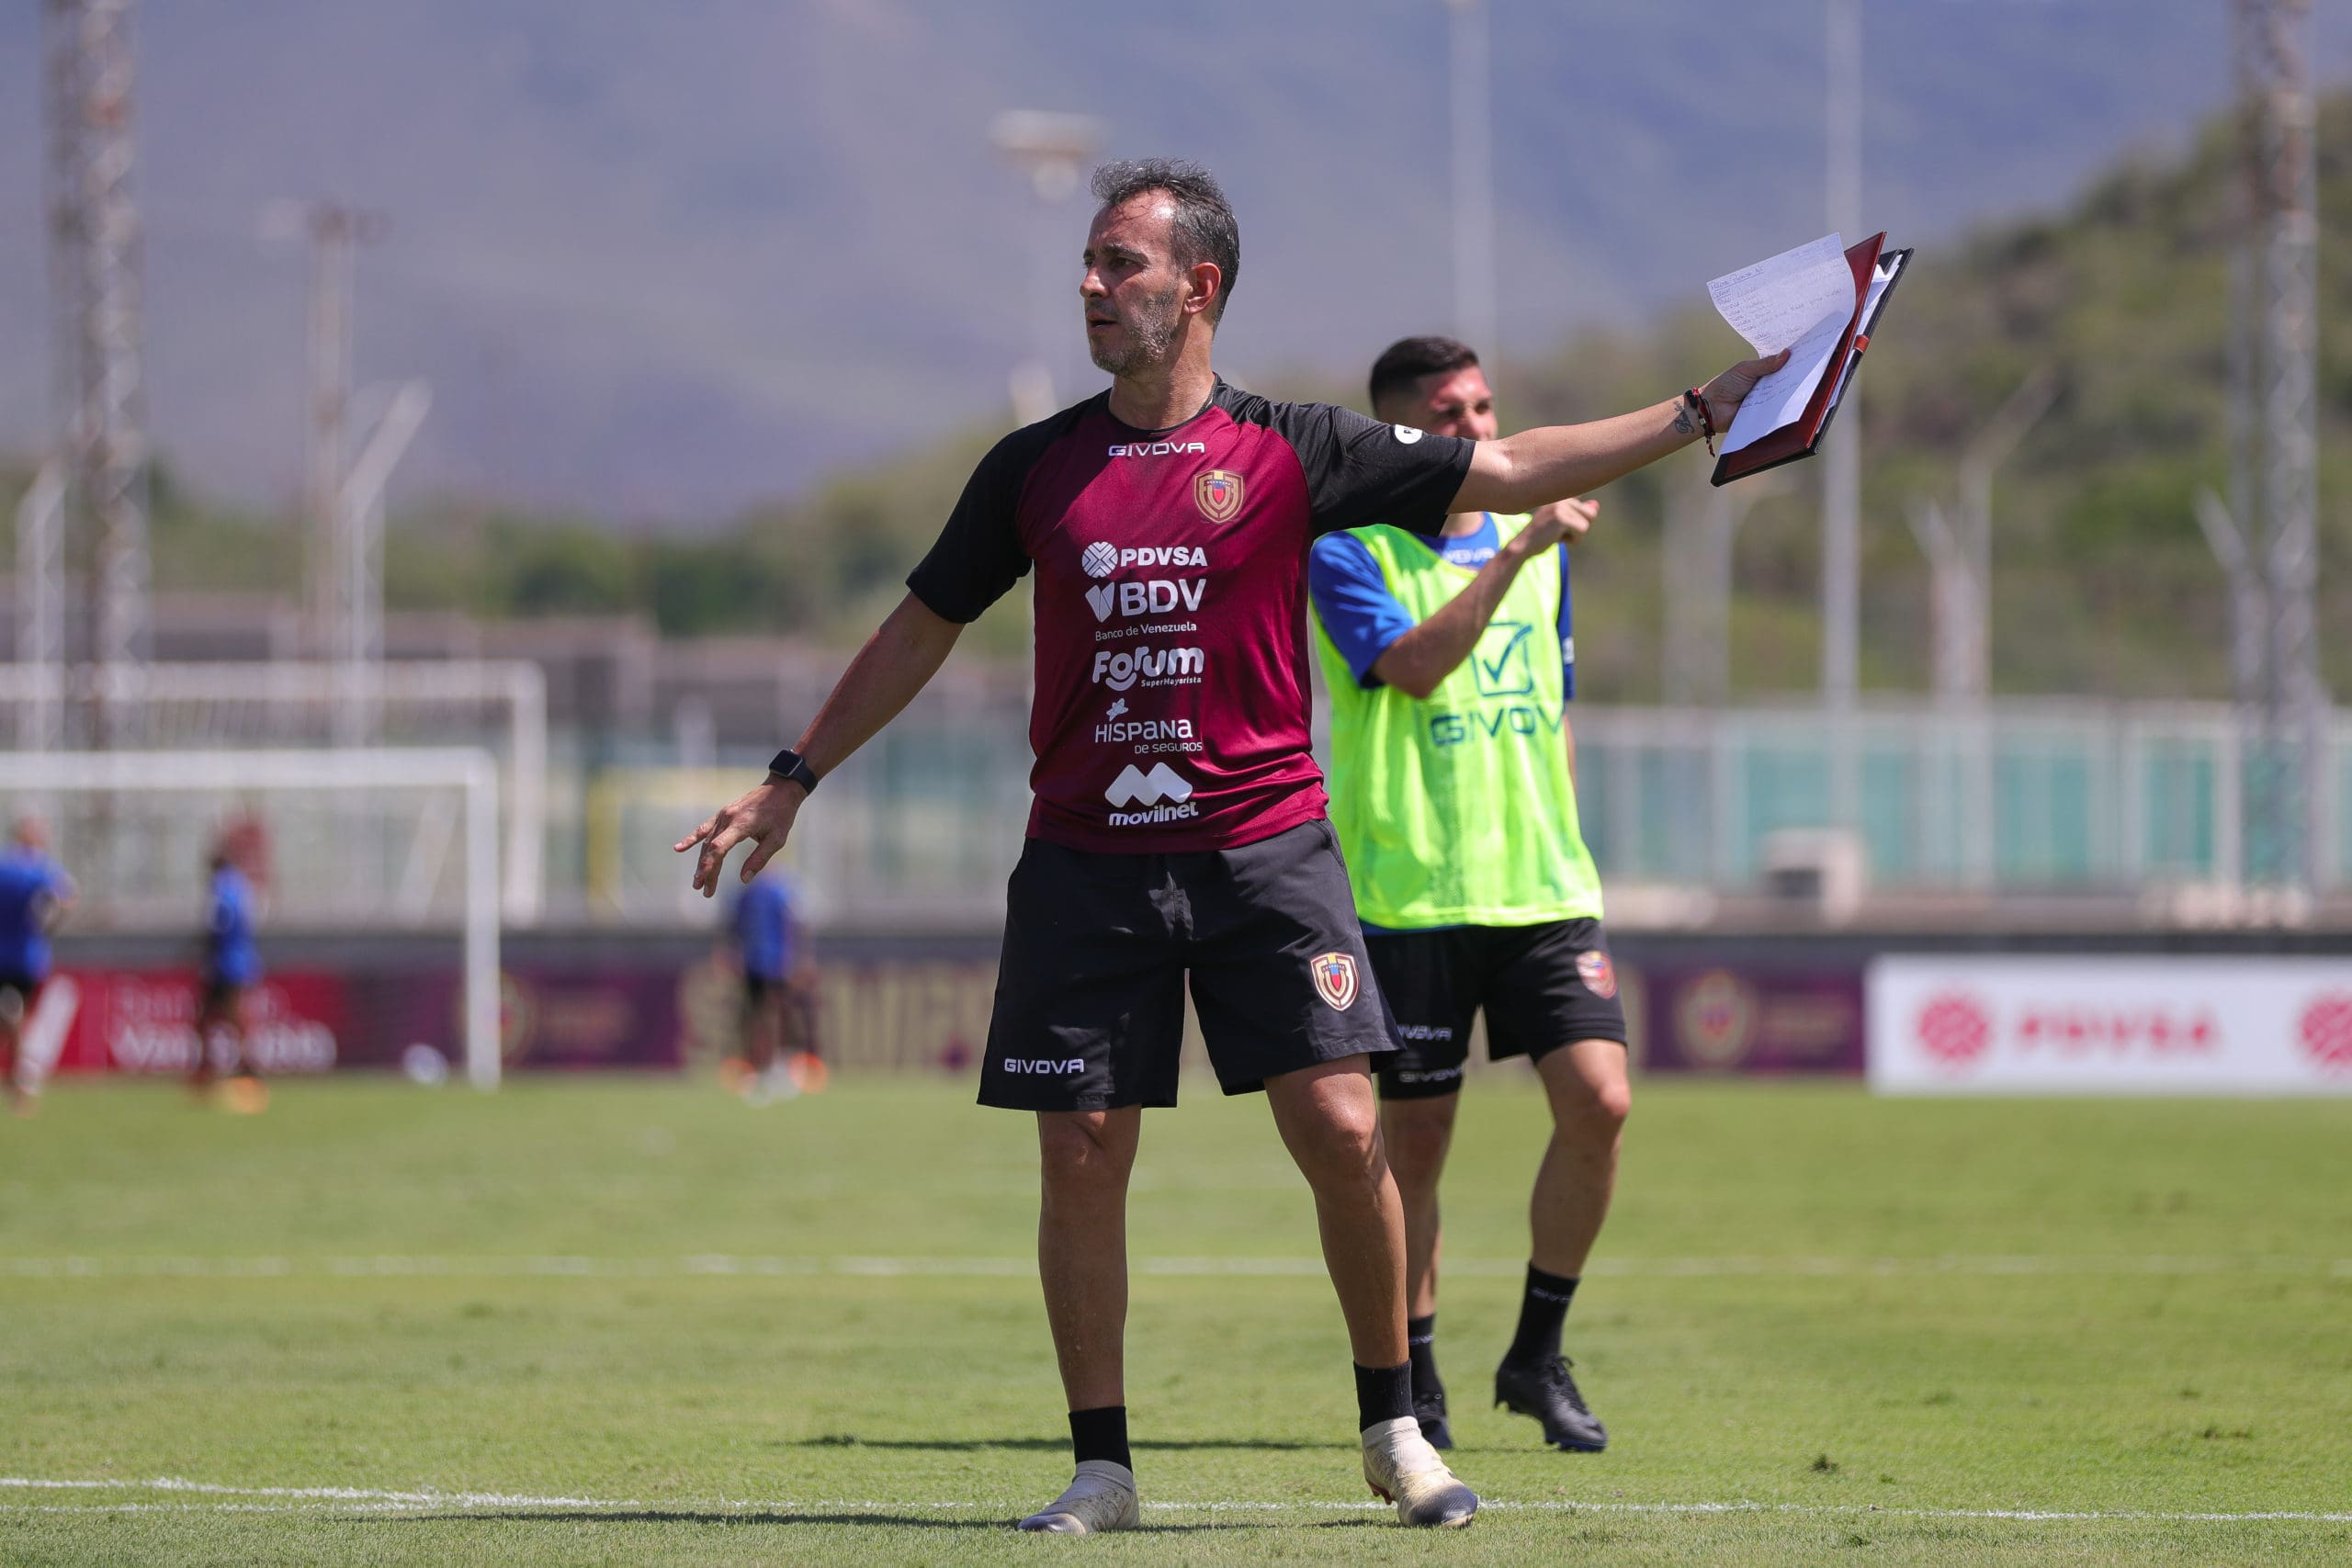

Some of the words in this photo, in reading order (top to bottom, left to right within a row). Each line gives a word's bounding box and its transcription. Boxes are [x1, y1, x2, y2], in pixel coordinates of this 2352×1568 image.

[1108, 442, 1205, 457] GIVOVA
[1120, 547, 1208, 567] PDVSA
[1119, 579, 1207, 616] BDV
[1095, 628, 1124, 641] Banco
[1125, 626, 1139, 637] de
[1140, 621, 1197, 635] Venezuela
[1091, 646, 1204, 685] Forum
[1141, 676, 1202, 688] SuperMayorista
[1430, 704, 1564, 748] GIVOV
[1108, 801, 1199, 826] movilnet
[1004, 1058, 1084, 1074] GIVOVA
